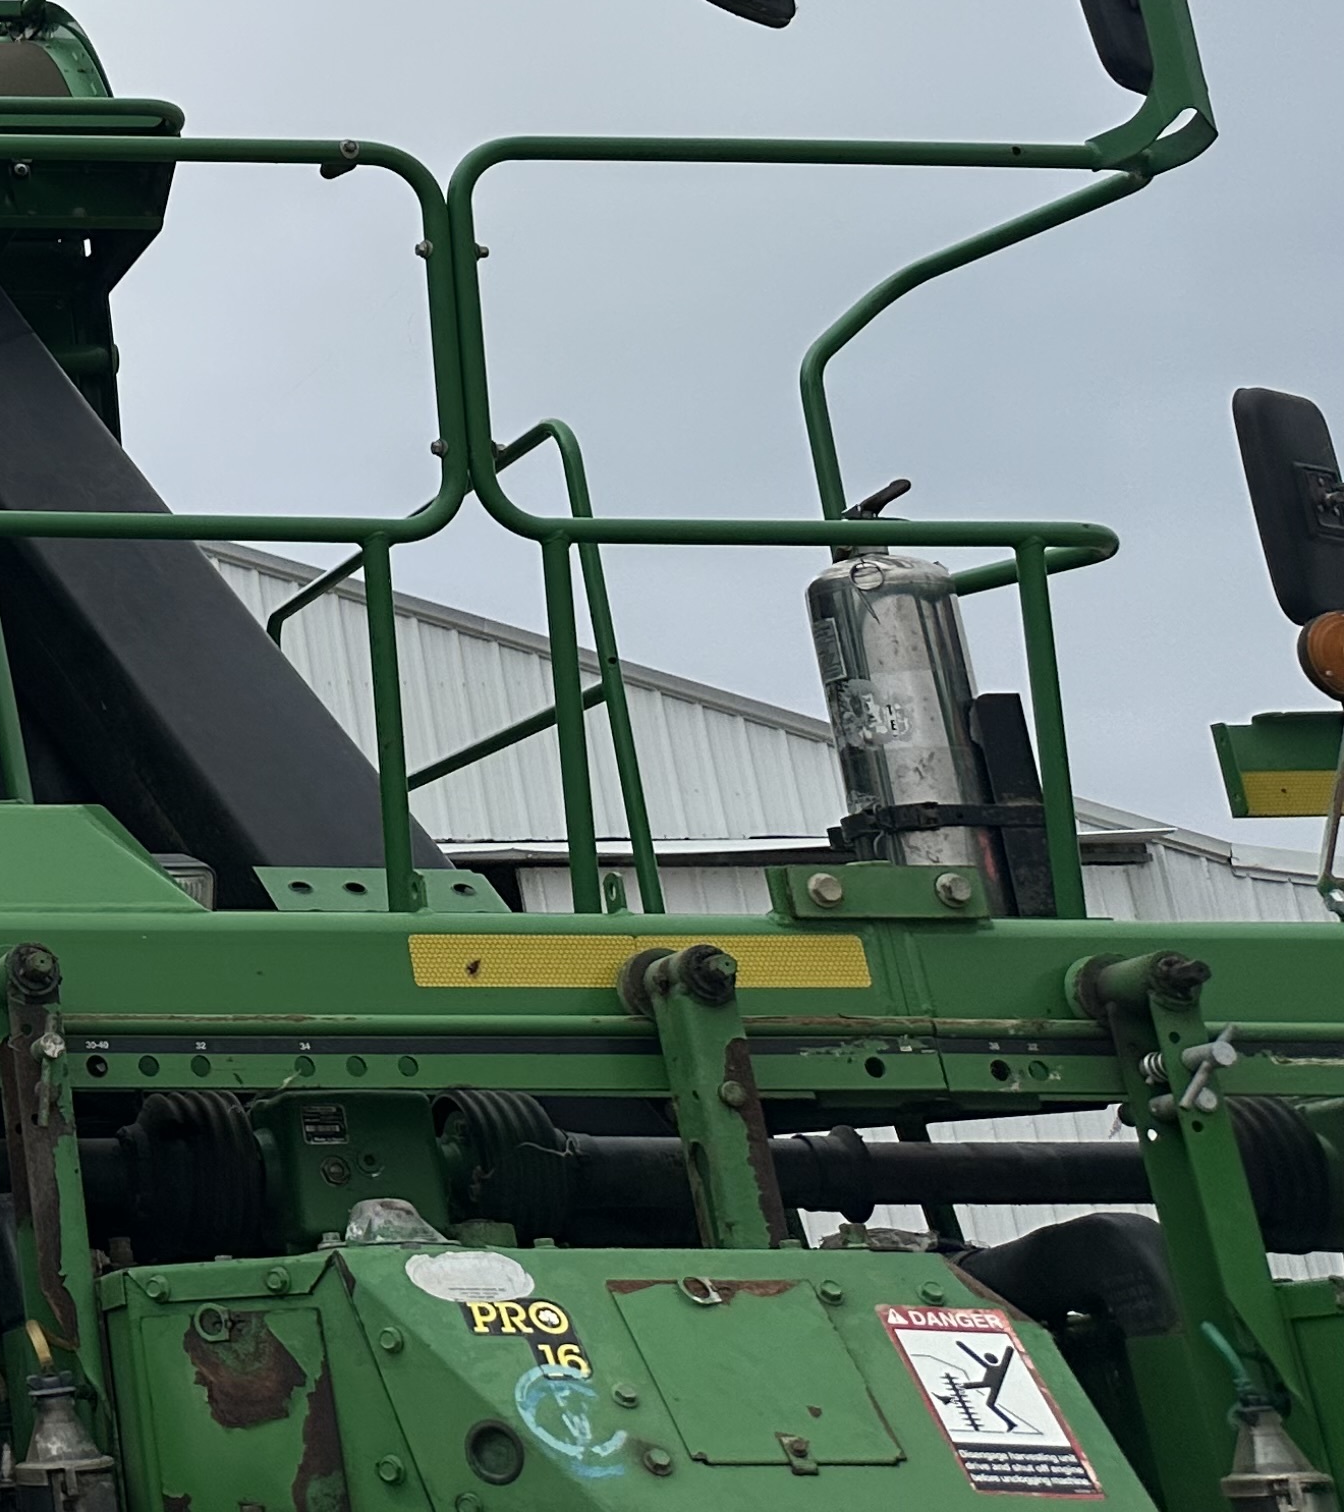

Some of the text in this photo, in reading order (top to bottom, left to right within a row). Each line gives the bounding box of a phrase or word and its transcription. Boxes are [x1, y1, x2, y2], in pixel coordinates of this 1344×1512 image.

[466, 1301, 569, 1335] PRO
[907, 1310, 1005, 1329] DANGER
[537, 1343, 592, 1378] 16
